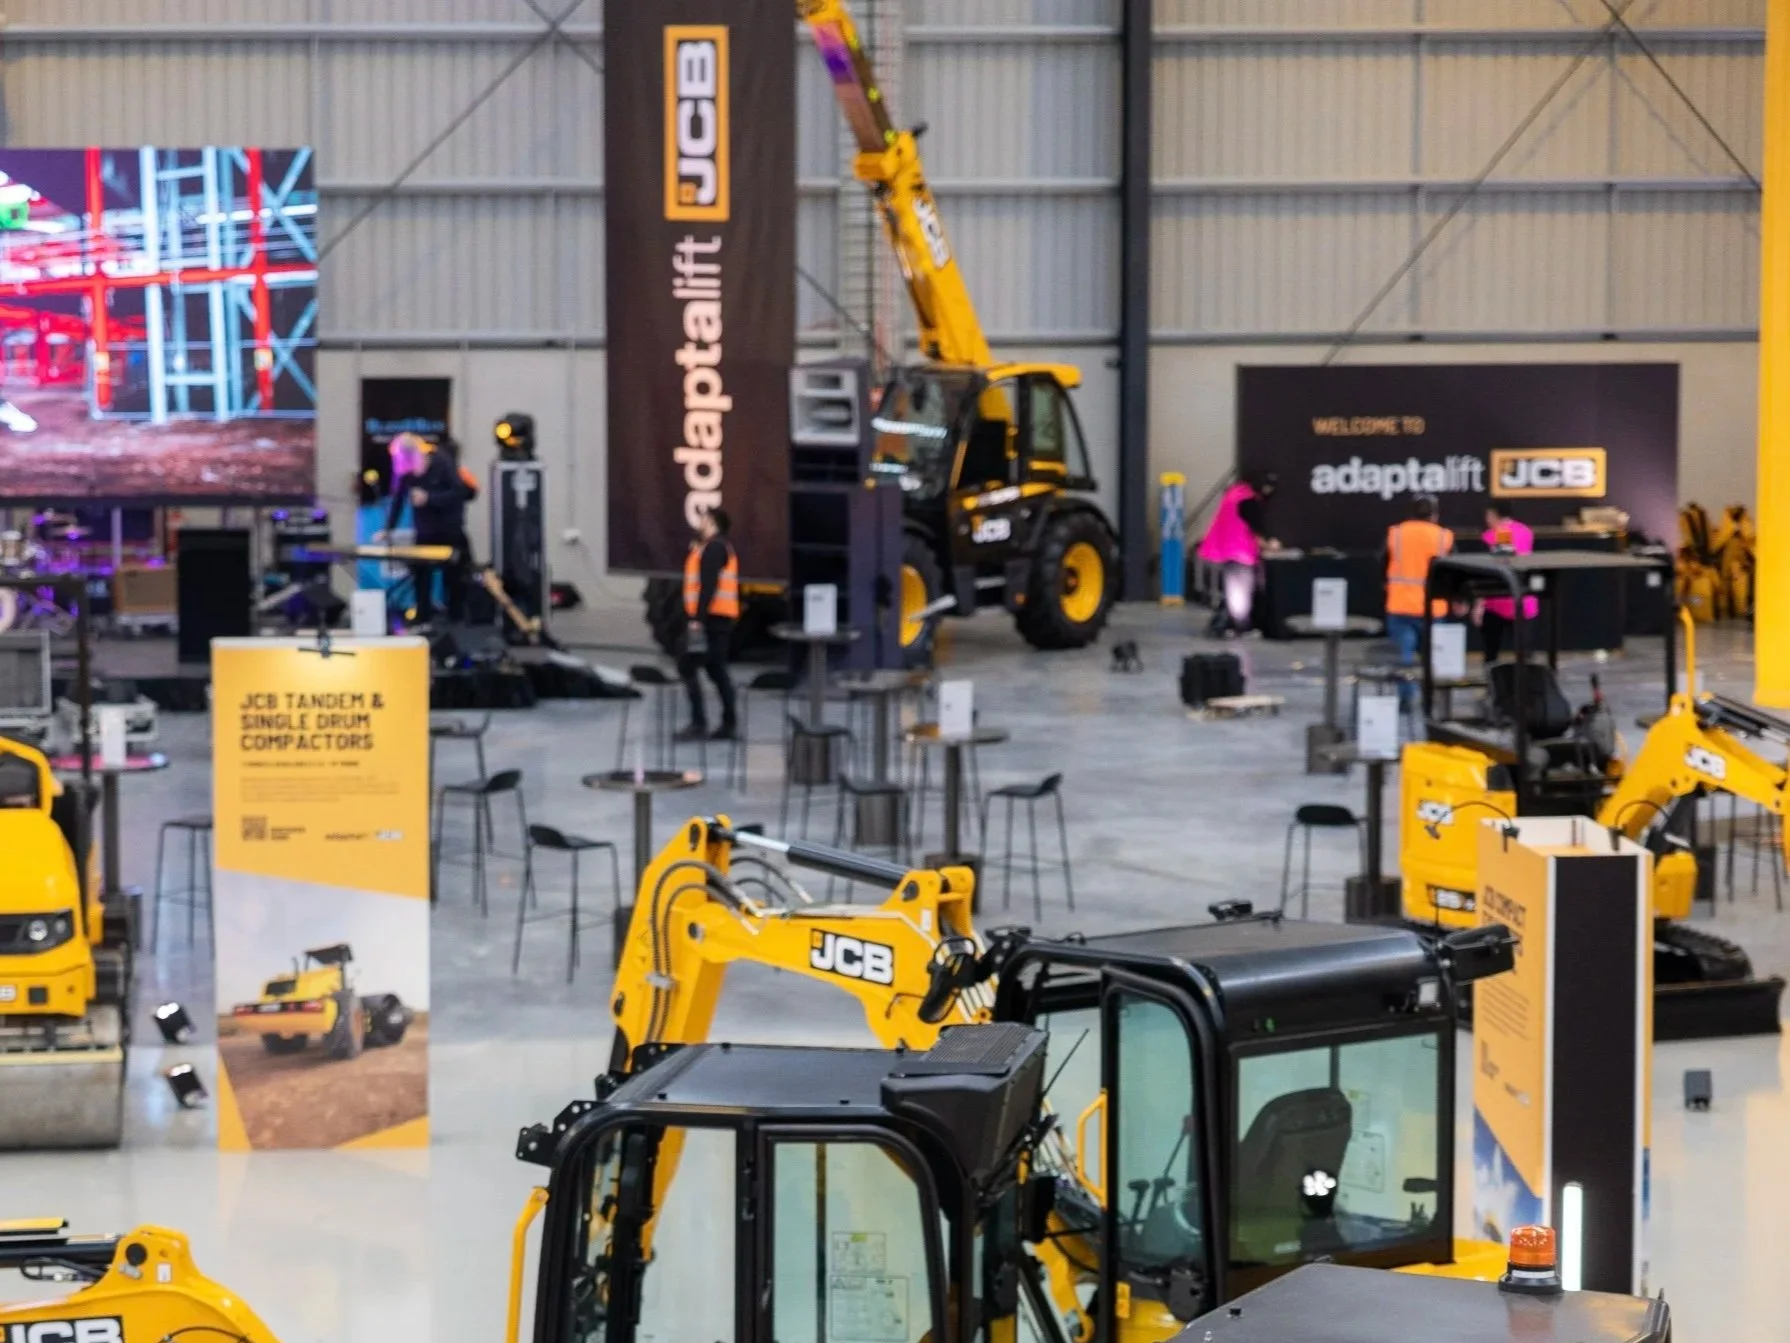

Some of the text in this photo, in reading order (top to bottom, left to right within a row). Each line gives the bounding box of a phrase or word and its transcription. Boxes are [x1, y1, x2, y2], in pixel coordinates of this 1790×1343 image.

[677, 40, 717, 205] JCB
[1312, 416, 1426, 436] WELCOME TO
[1310, 454, 1596, 500] adaptalift JCB
[240, 692, 384, 710] JCB TANDEM &
[240, 713, 371, 730] SINGLE DRUM
[240, 733, 374, 751] COMPACTORS
[810, 931, 894, 986] JCB
